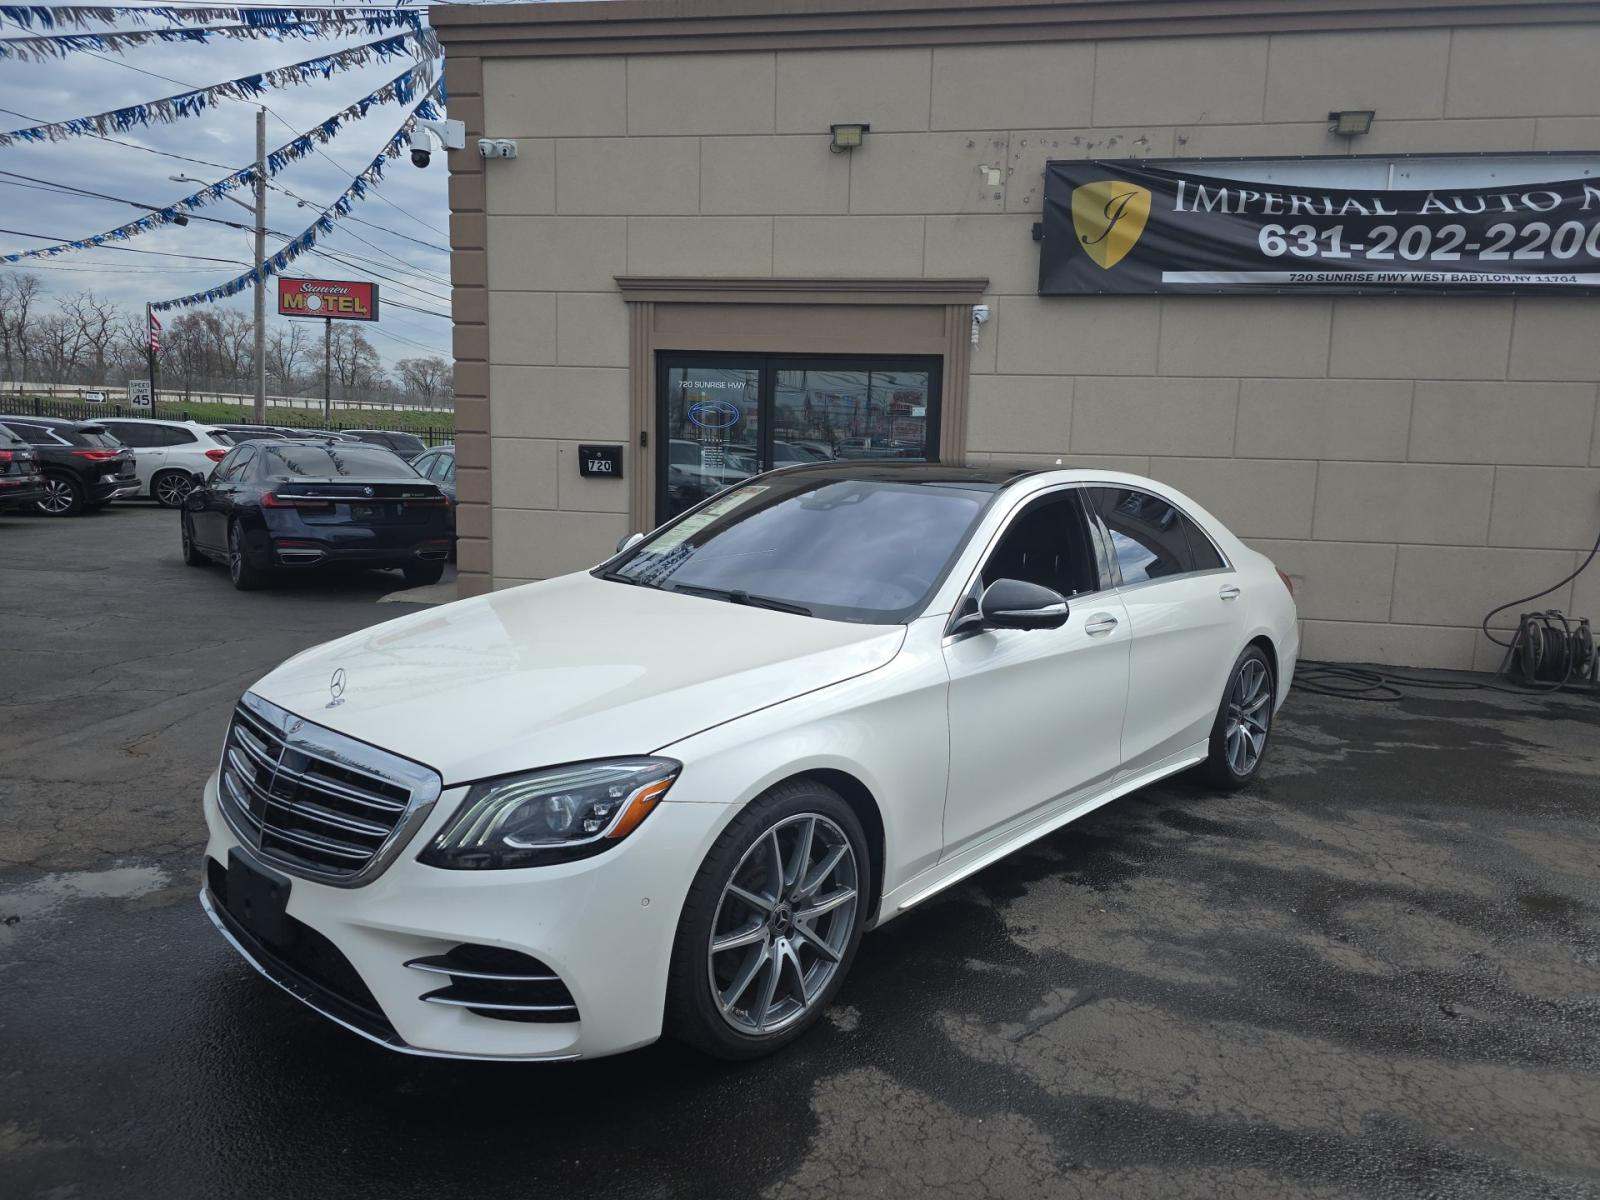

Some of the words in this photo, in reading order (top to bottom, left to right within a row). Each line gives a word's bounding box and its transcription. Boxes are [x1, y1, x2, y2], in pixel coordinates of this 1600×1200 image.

[1171, 180, 1398, 216] IMPERIAL
[1416, 190, 1563, 215] AUTO
[1289, 273, 1314, 282] 720
[1316, 273, 1375, 282] SUNRISE
[1377, 273, 1408, 282] HWY
[1410, 273, 1447, 283] WEST
[283, 292, 368, 315] MOTEL
[694, 381, 726, 389] SUNRISE
[133, 395, 150, 405] 45
[589, 460, 611, 471] 720
